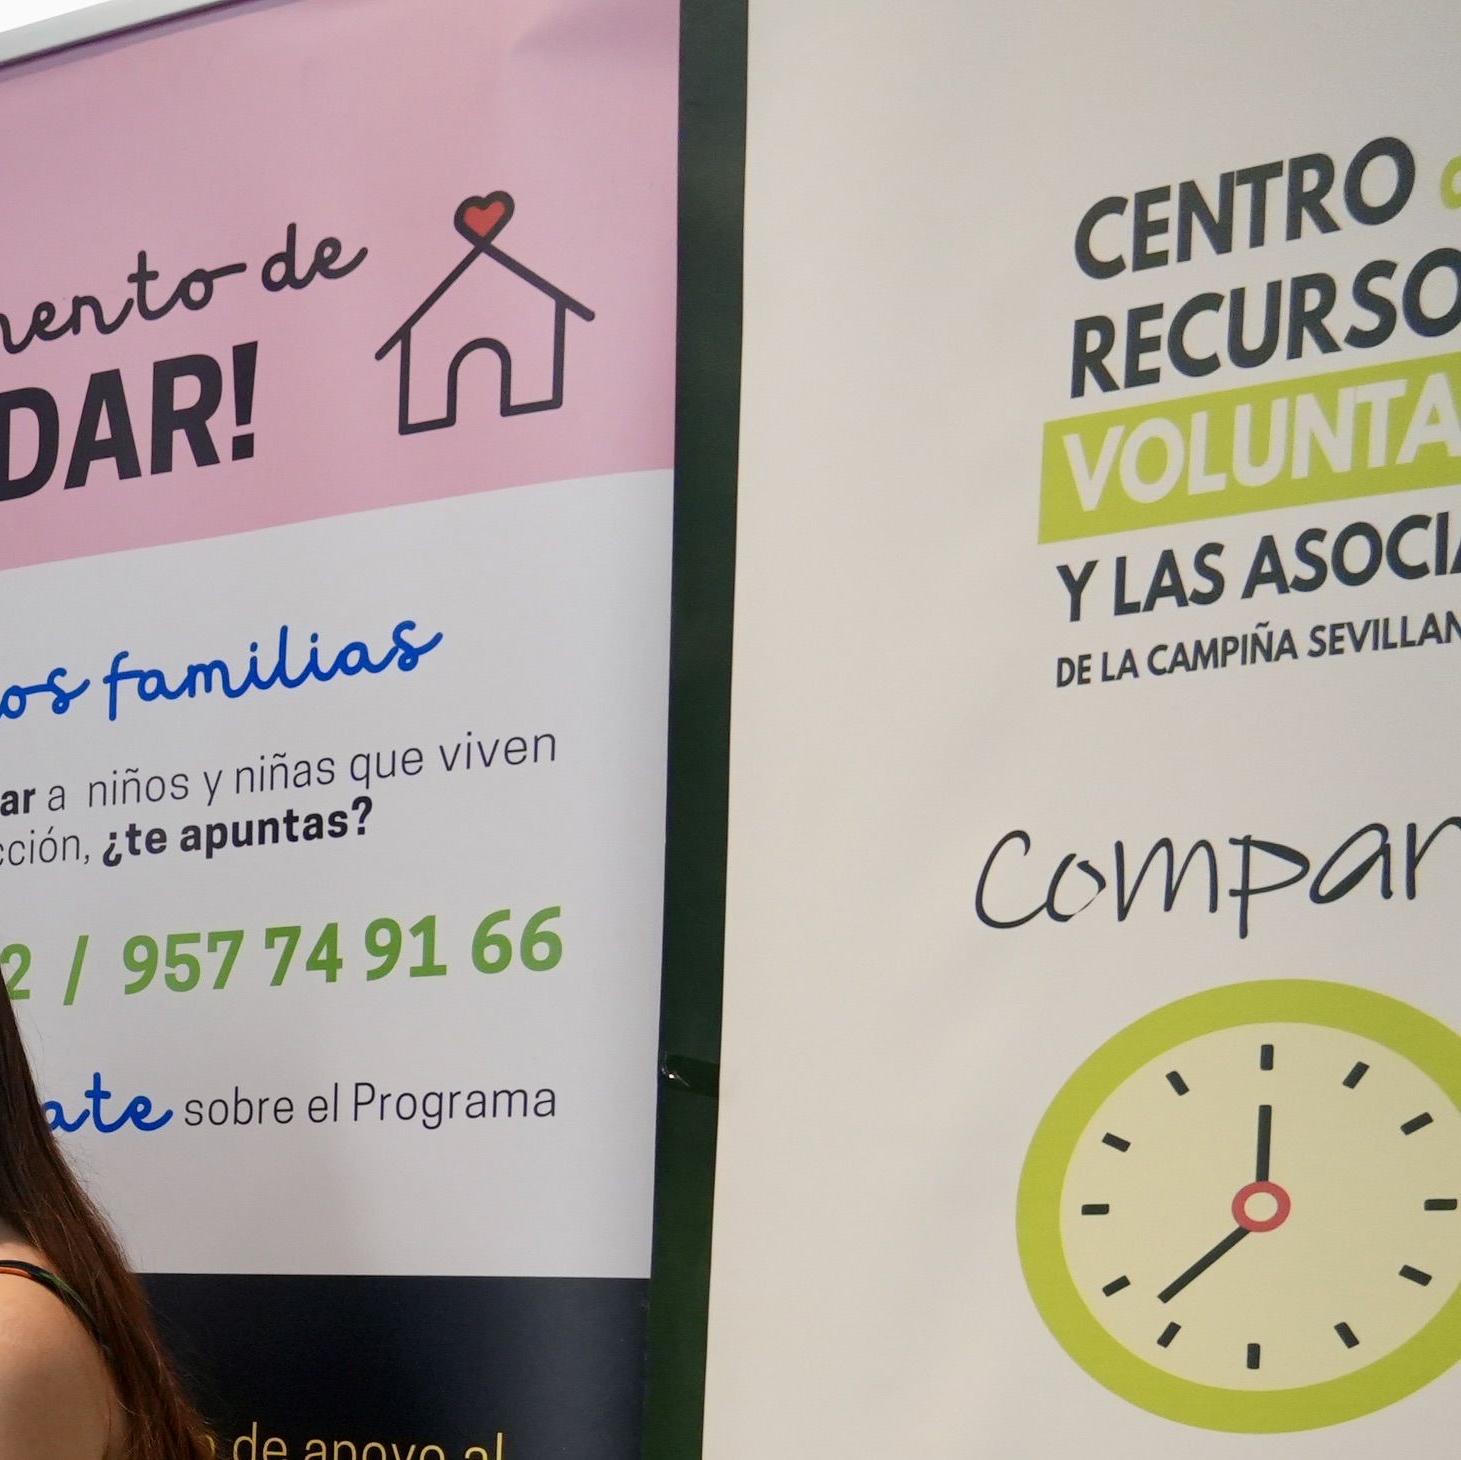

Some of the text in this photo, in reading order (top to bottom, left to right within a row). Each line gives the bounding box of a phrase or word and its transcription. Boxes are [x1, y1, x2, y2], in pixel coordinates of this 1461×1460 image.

[1073, 136, 1416, 280] CENTRO
[261, 223, 369, 294] de
[1061, 372, 1461, 512] VOLUNTA
[1055, 510, 1461, 623] Y LAS ASOCI
[103, 619, 444, 722] familias
[1055, 610, 1461, 689] DE LA CAMPIÑA SEVILLAN
[47, 784, 66, 812] a
[88, 767, 190, 808] niños
[202, 769, 223, 806] y
[234, 752, 336, 794] niñas
[349, 746, 424, 790] que
[439, 730, 556, 772] viven
[102, 822, 168, 867] ¿te
[179, 795, 374, 860] apuntas?
[0, 942, 31, 1001] 2
[121, 929, 246, 997] 957
[262, 924, 345, 988] 74
[362, 917, 448, 981] 91
[469, 906, 565, 975] 66
[183, 1080, 559, 1131] sobre el Programa
